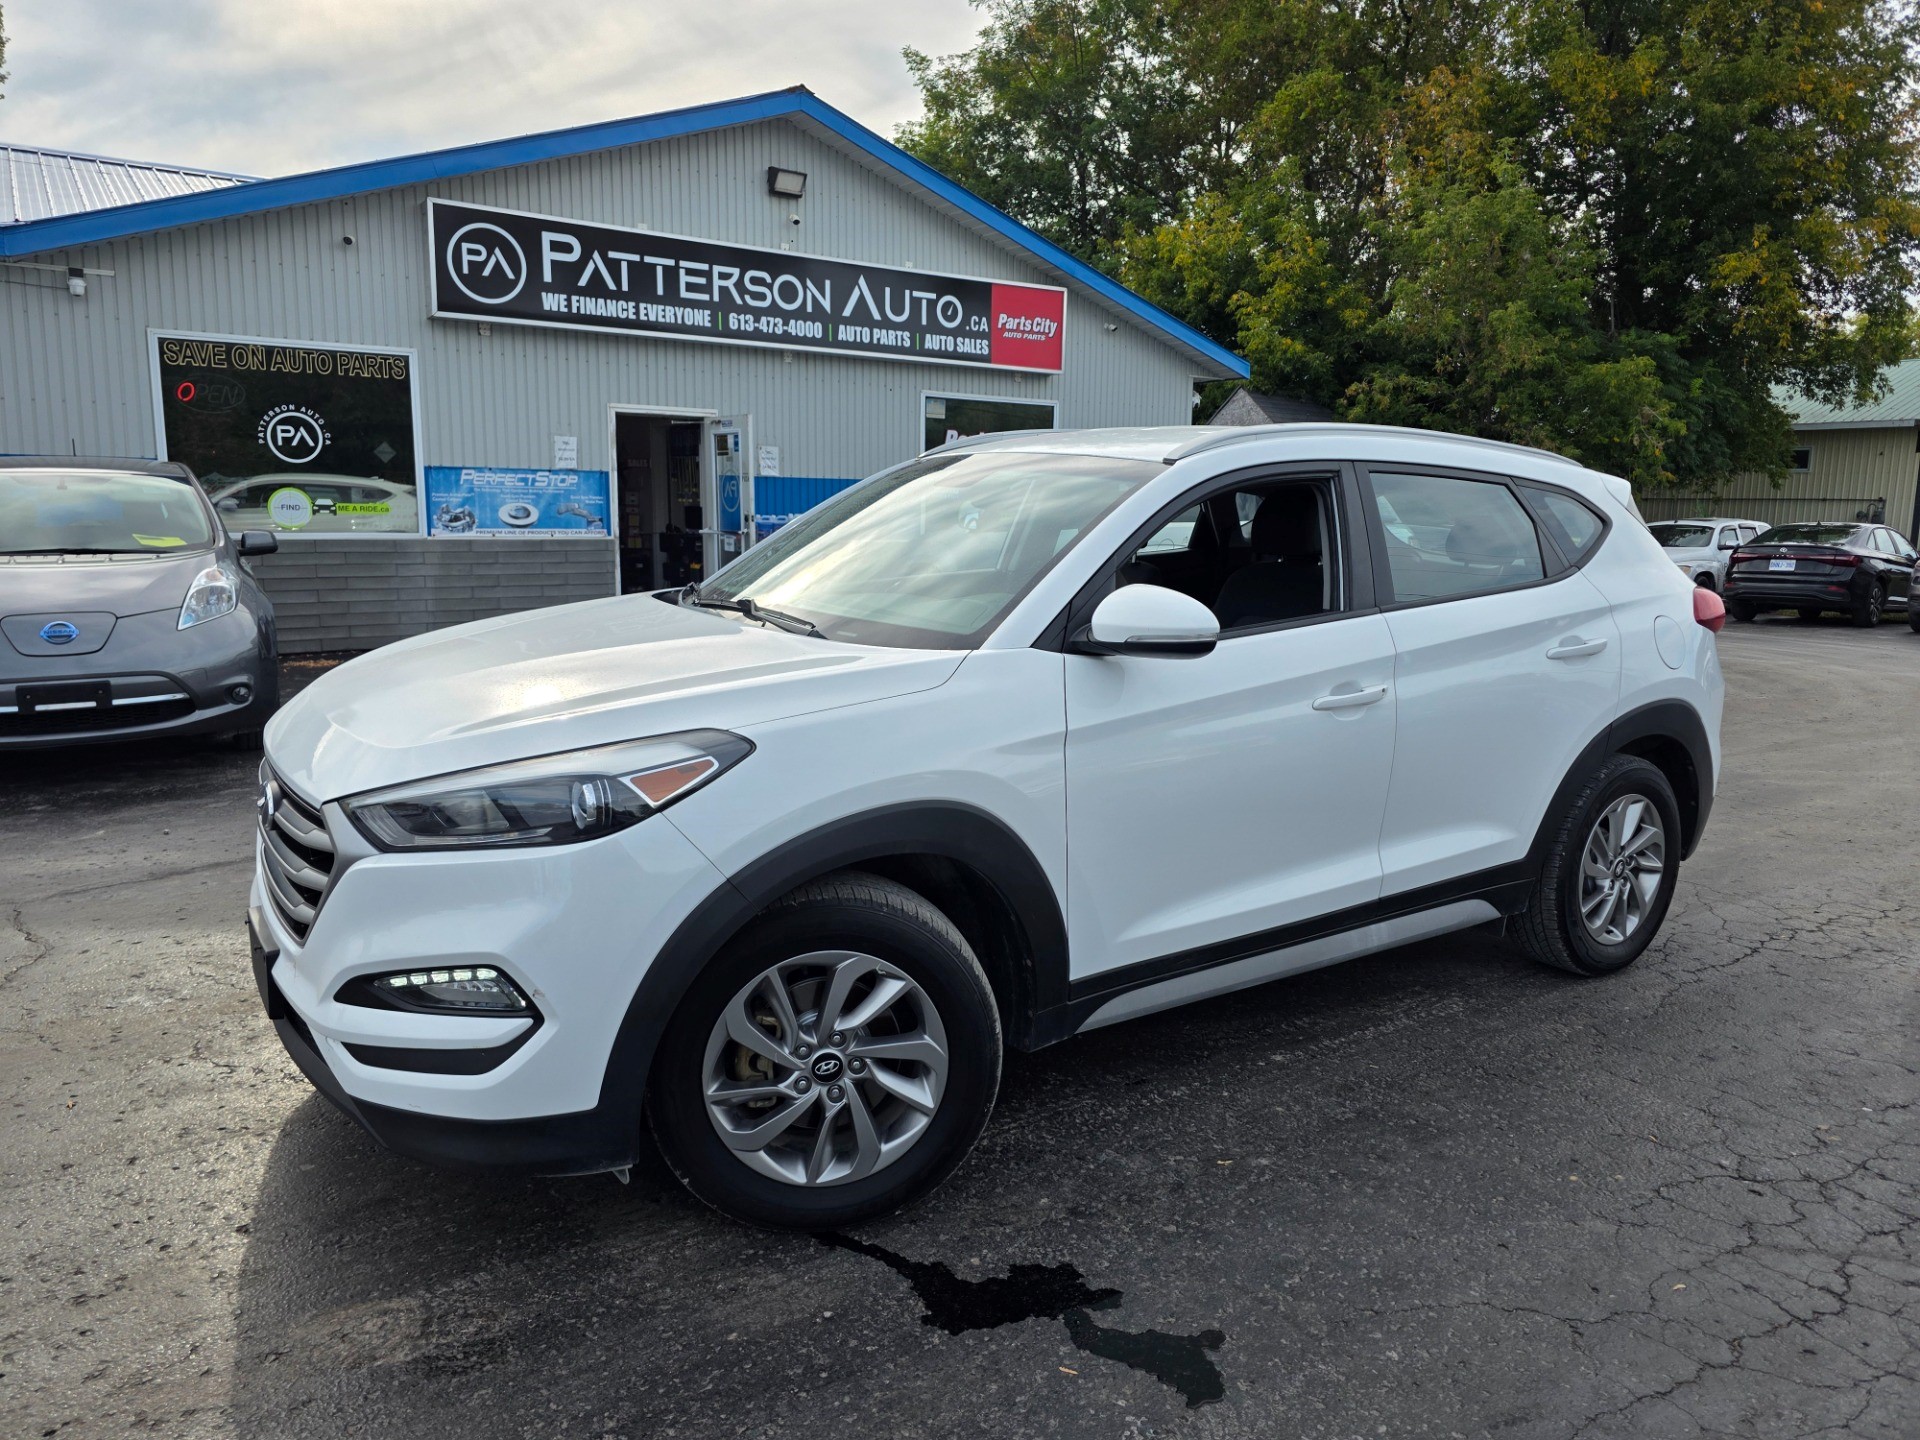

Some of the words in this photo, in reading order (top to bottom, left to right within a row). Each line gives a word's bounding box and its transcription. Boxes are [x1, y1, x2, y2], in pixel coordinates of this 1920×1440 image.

[461, 242, 515, 279] PA
[541, 231, 831, 314] PATTERSON
[842, 274, 963, 328] AUTO
[541, 292, 568, 313] WE
[571, 295, 636, 320] FINANCE
[639, 302, 712, 328] EVERYONE
[728, 313, 823, 339] 613-473-4000
[838, 324, 871, 343] AUTO
[873, 328, 911, 347] PARTS
[924, 333, 954, 353] AUTO
[956, 337, 989, 355] SALES
[1003, 331, 1022, 339] AUTO
[1023, 332, 1046, 341] PARTS
[163, 340, 227, 368] SAVE
[231, 345, 267, 370] ON
[271, 348, 332, 375] AUTO
[338, 352, 406, 379] PARTS
[258, 404, 295, 444] PATTERSON
[300, 406, 325, 425] AUTO
[276, 425, 315, 447] PA
[360, 505, 390, 513] RIDE.ca
